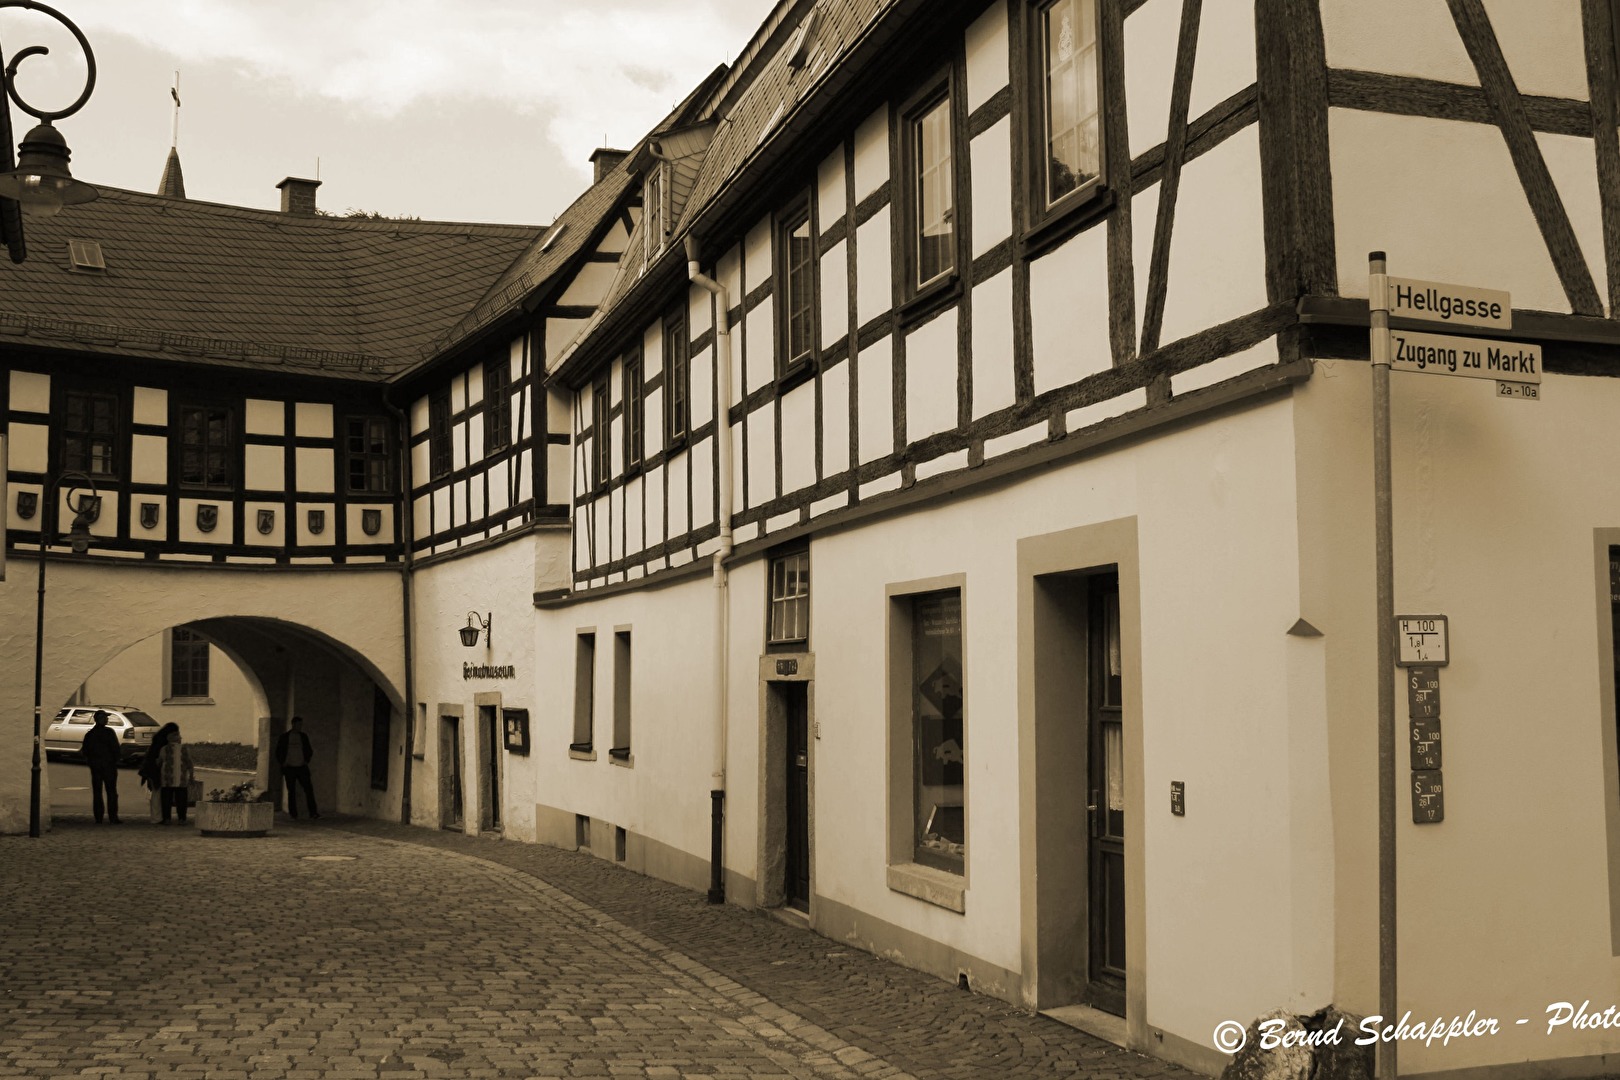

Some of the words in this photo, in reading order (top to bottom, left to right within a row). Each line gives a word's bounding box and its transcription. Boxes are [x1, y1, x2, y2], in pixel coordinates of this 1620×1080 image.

[1396, 285, 1502, 320] Hellgasse
[1396, 338, 1457, 372] Zugang
[1463, 350, 1481, 369] zu
[1487, 347, 1535, 374] Markt
[1500, 383, 1512, 396] 2a
[1521, 386, 1537, 398] 10a
[1402, 620, 1409, 631] H
[1417, 620, 1435, 632] 100
[1411, 677, 1418, 689] S
[1426, 680, 1438, 689] 100
[1413, 728, 1420, 741] S
[1428, 732, 1440, 740] 100
[1415, 781, 1422, 794] S
[1430, 785, 1442, 793] 100
